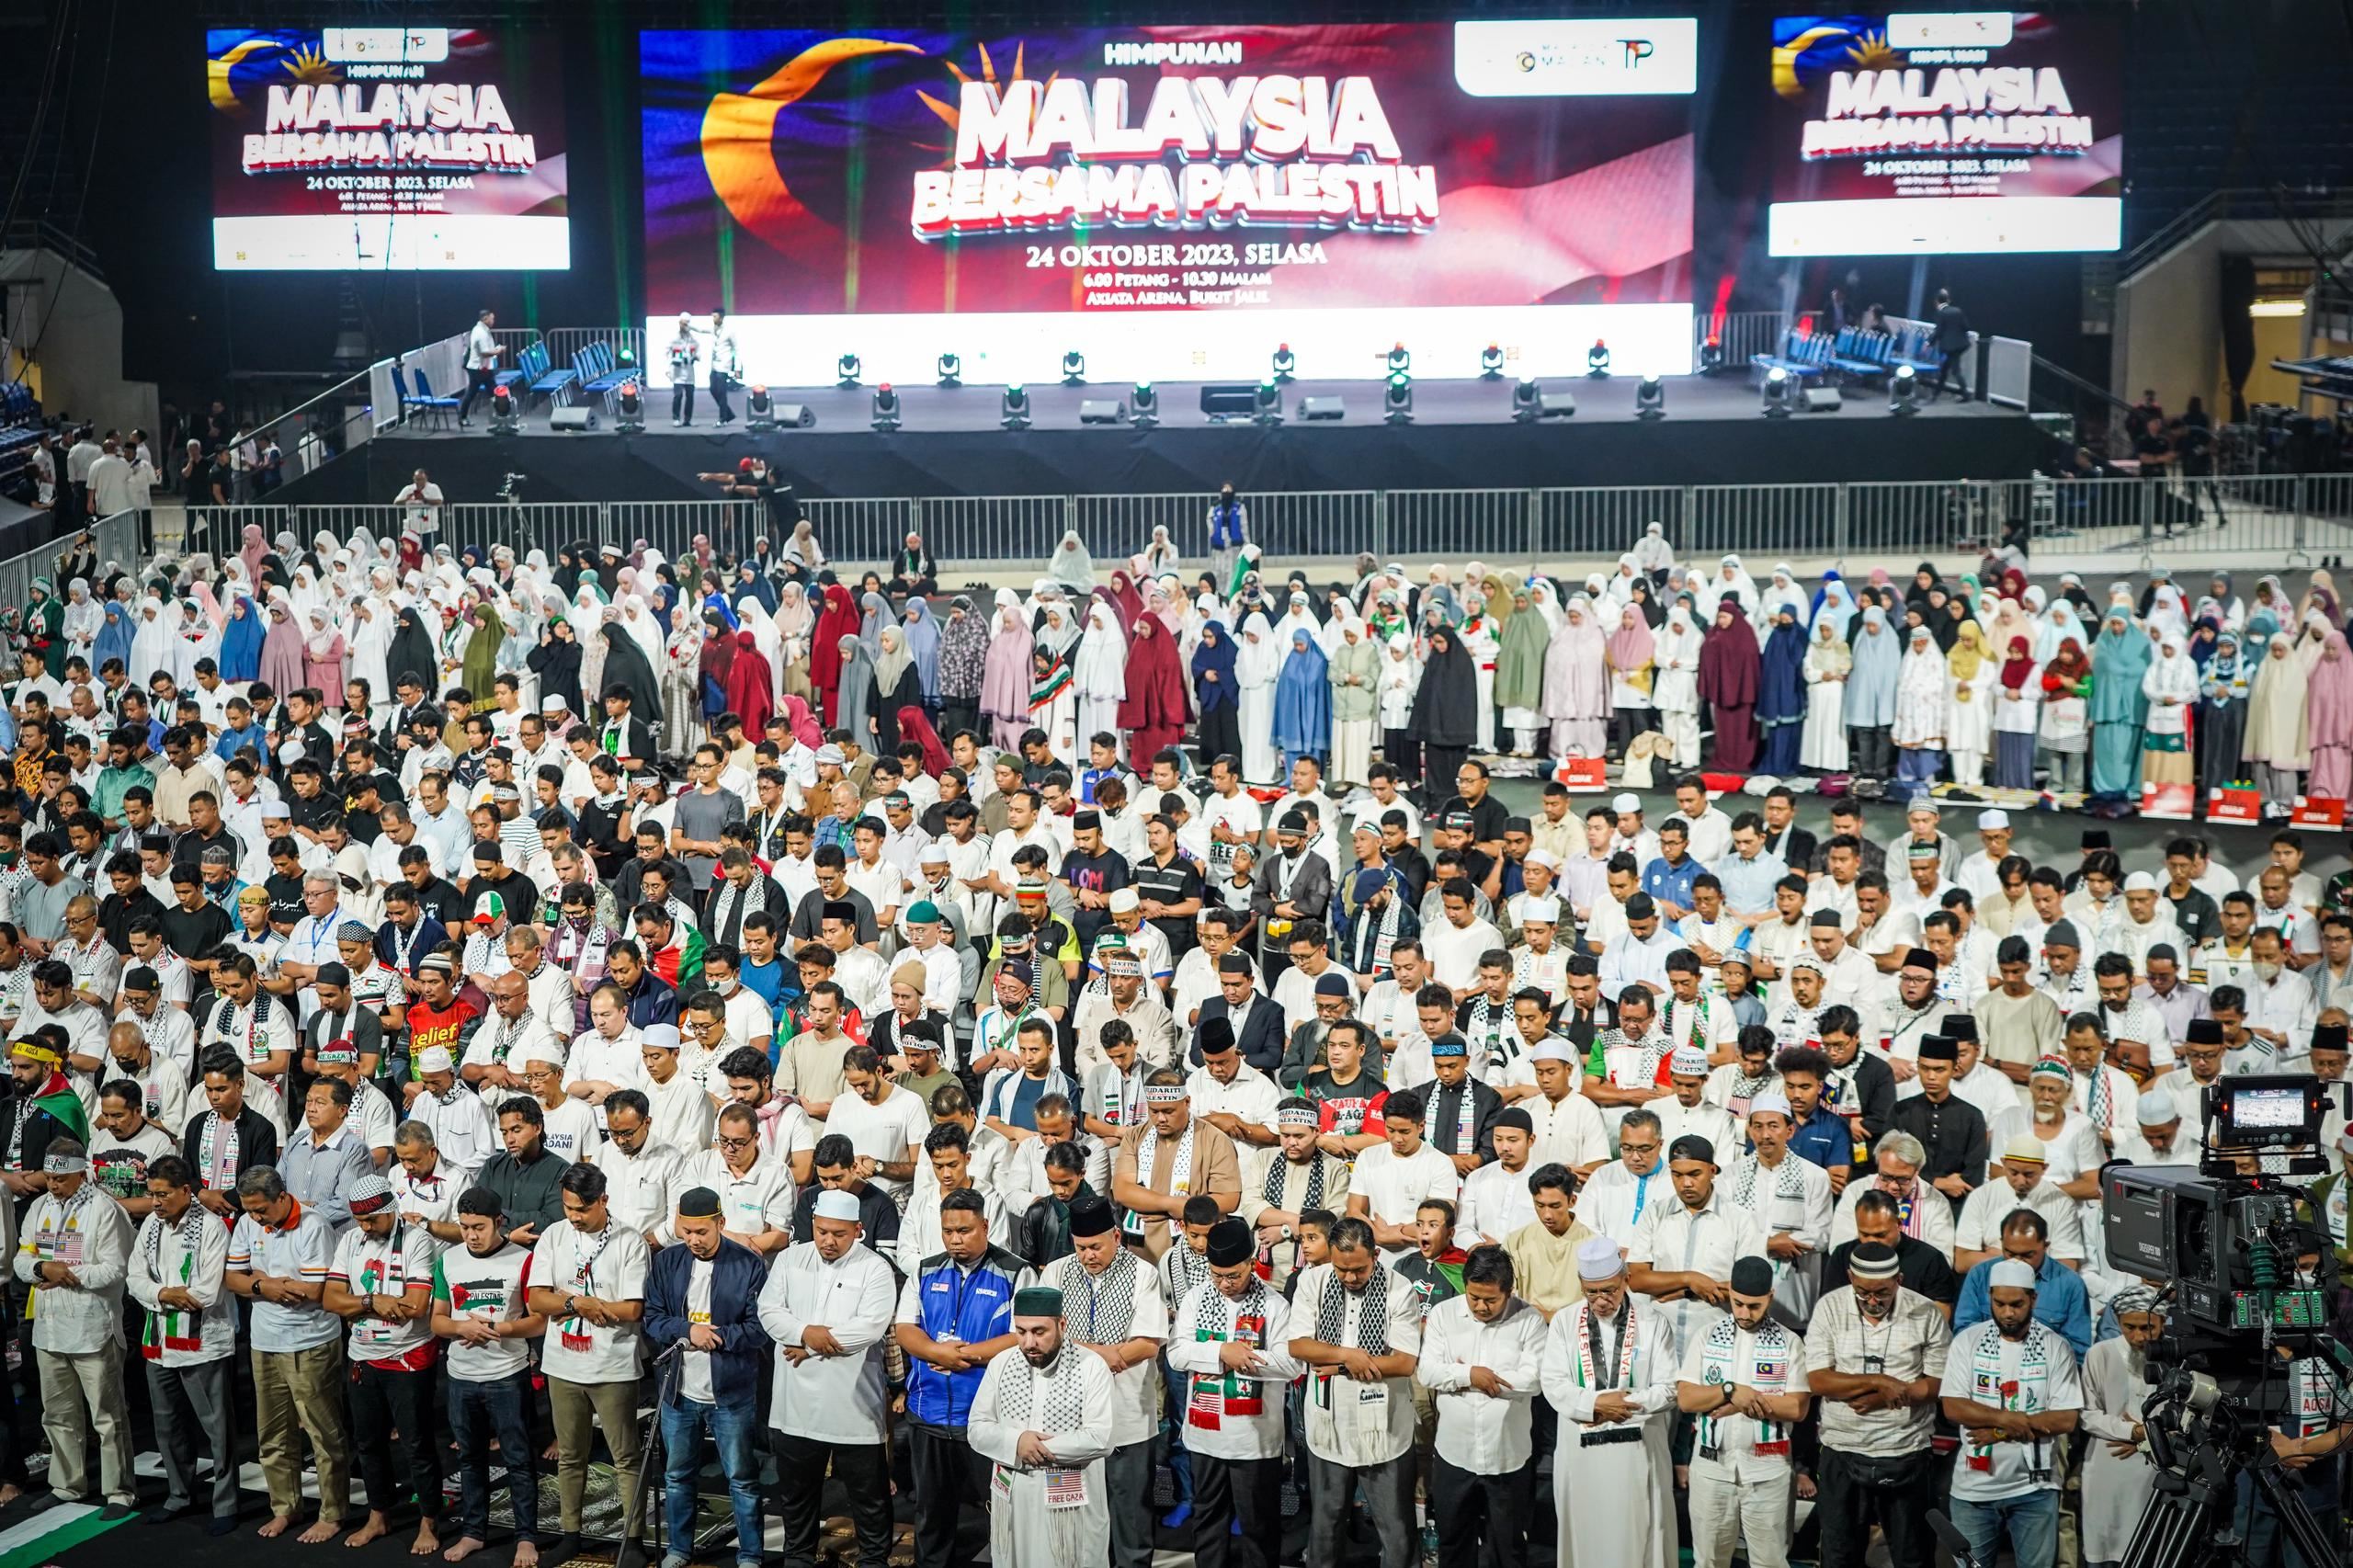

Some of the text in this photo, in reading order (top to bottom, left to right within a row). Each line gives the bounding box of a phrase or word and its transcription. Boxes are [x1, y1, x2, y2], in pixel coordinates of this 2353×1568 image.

[1105, 42, 1242, 65] HIMPUNAN
[347, 64, 425, 78] HIMPUNAN
[1827, 67, 2074, 119] MALAYSIA
[266, 83, 515, 133] MALAYSIA
[956, 75, 1404, 165] MALAYSIA
[1951, 115, 2094, 153] PALESTIN
[243, 131, 537, 173] BERSAMA PALESTIN
[307, 176, 324, 190] 24
[325, 176, 392, 190] OKTOBER
[427, 175, 475, 189] SELASA
[911, 163, 1439, 233] BERSAMA PALESTIN
[1026, 243, 1328, 267] 24 OKTOBER 2023, SELASA
[1083, 272, 1113, 287] 6.00
[1114, 272, 1170, 287] PETANG
[1182, 271, 1218, 287] 10.30
[1220, 271, 1273, 287] MALAM
[542, 1140, 573, 1150] ADANI
[545, 1133, 573, 1142] LAYSIA
[1579, 1306, 1594, 1381] PALESTINE
[1048, 1493, 1086, 1504] FREE GAZA
